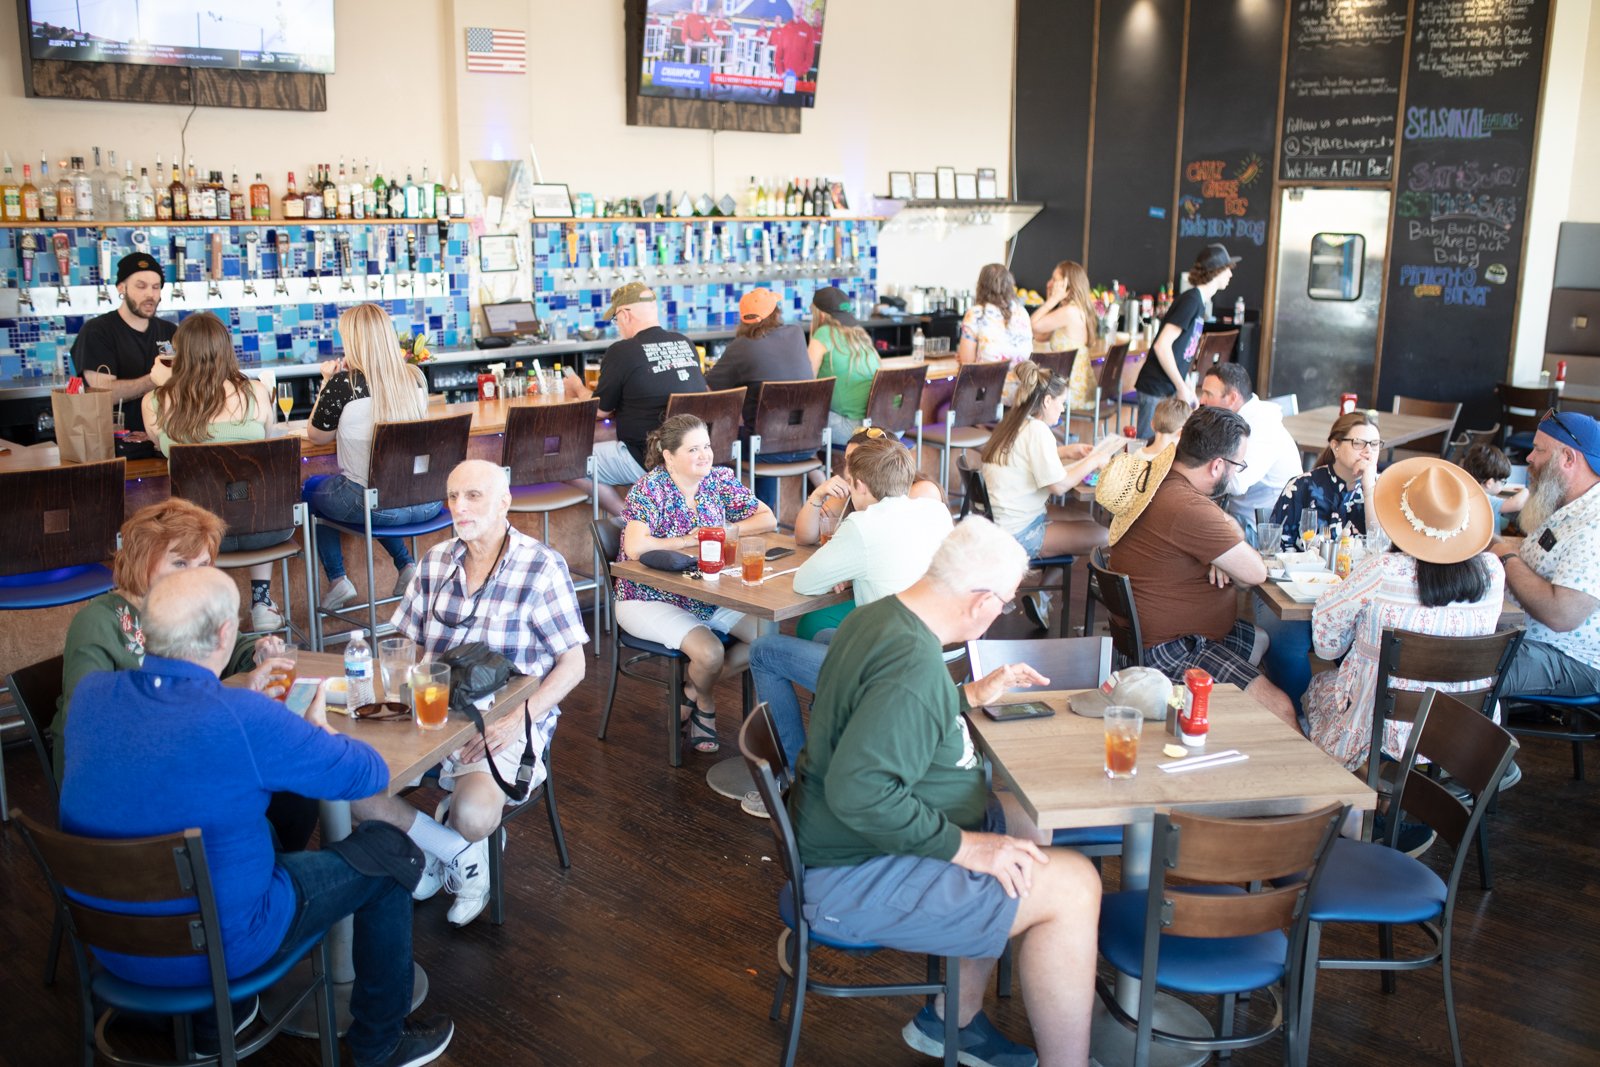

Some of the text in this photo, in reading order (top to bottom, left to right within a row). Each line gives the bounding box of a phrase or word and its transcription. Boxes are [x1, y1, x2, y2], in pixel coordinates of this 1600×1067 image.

[1336, 118, 1349, 127] on
[1404, 106, 1492, 139] SEASONAL
[1329, 160, 1339, 178] A
[1409, 220, 1446, 246] Baby
[1478, 223, 1511, 243] Ribs
[1465, 236, 1505, 252] Back
[1434, 248, 1480, 269] Baby
